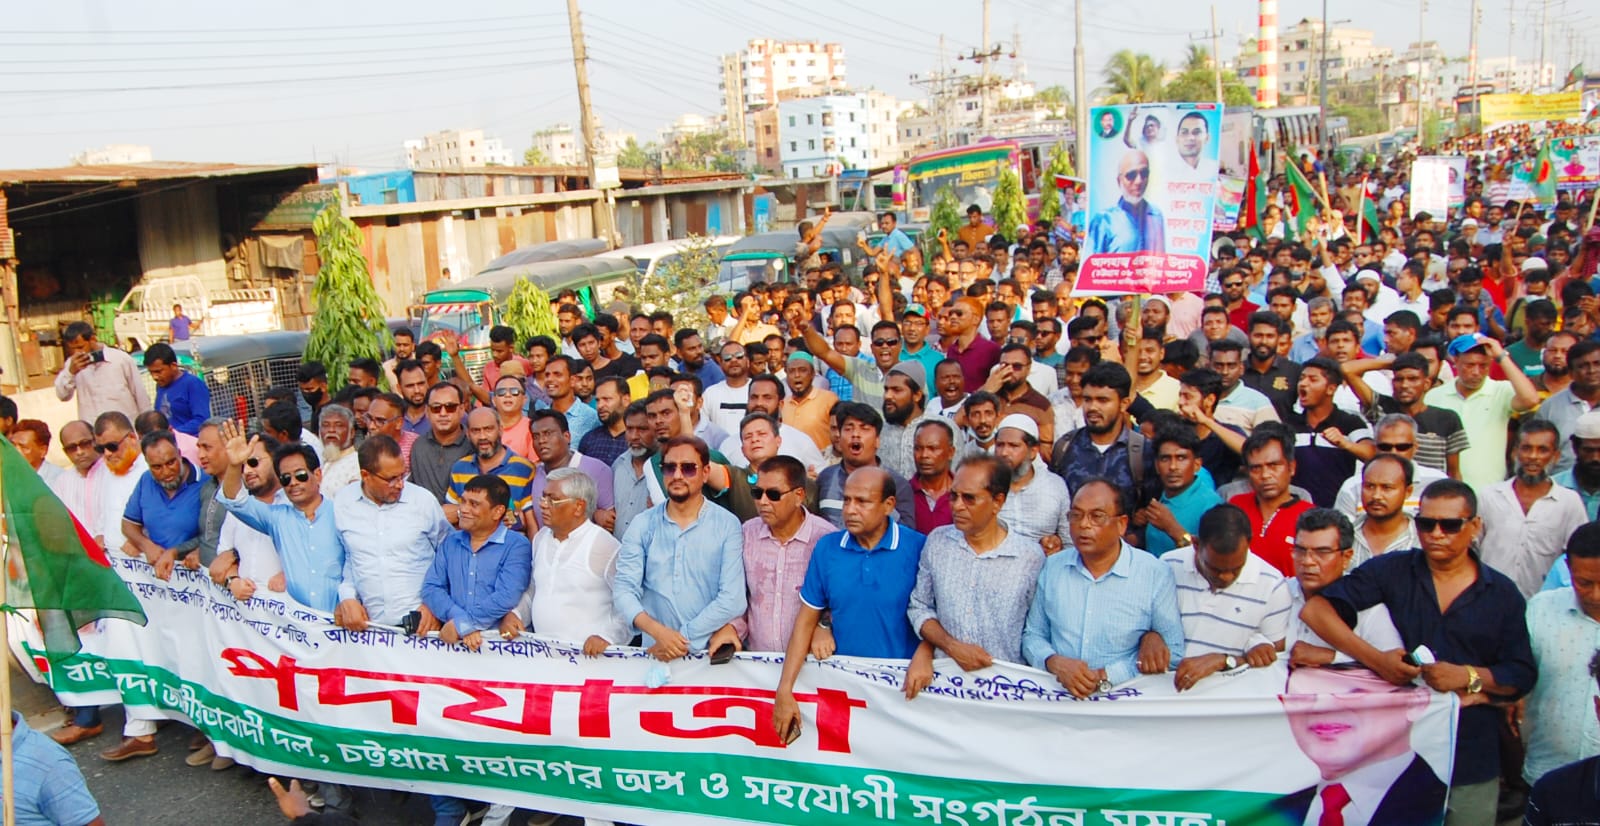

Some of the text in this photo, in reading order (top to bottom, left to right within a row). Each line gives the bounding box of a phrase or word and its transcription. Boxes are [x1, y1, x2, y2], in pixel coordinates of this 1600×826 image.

[221, 647, 868, 754] পদযাত্রা
[270, 727, 330, 764] দল,
[336, 740, 450, 772] চট্টগ্রাম
[455, 754, 602, 789] মহানগর
[611, 767, 686, 797] অঙ্গ
[699, 772, 730, 799] ও
[741, 774, 899, 821] সহযোগী
[908, 794, 1088, 826] সংগঠন
